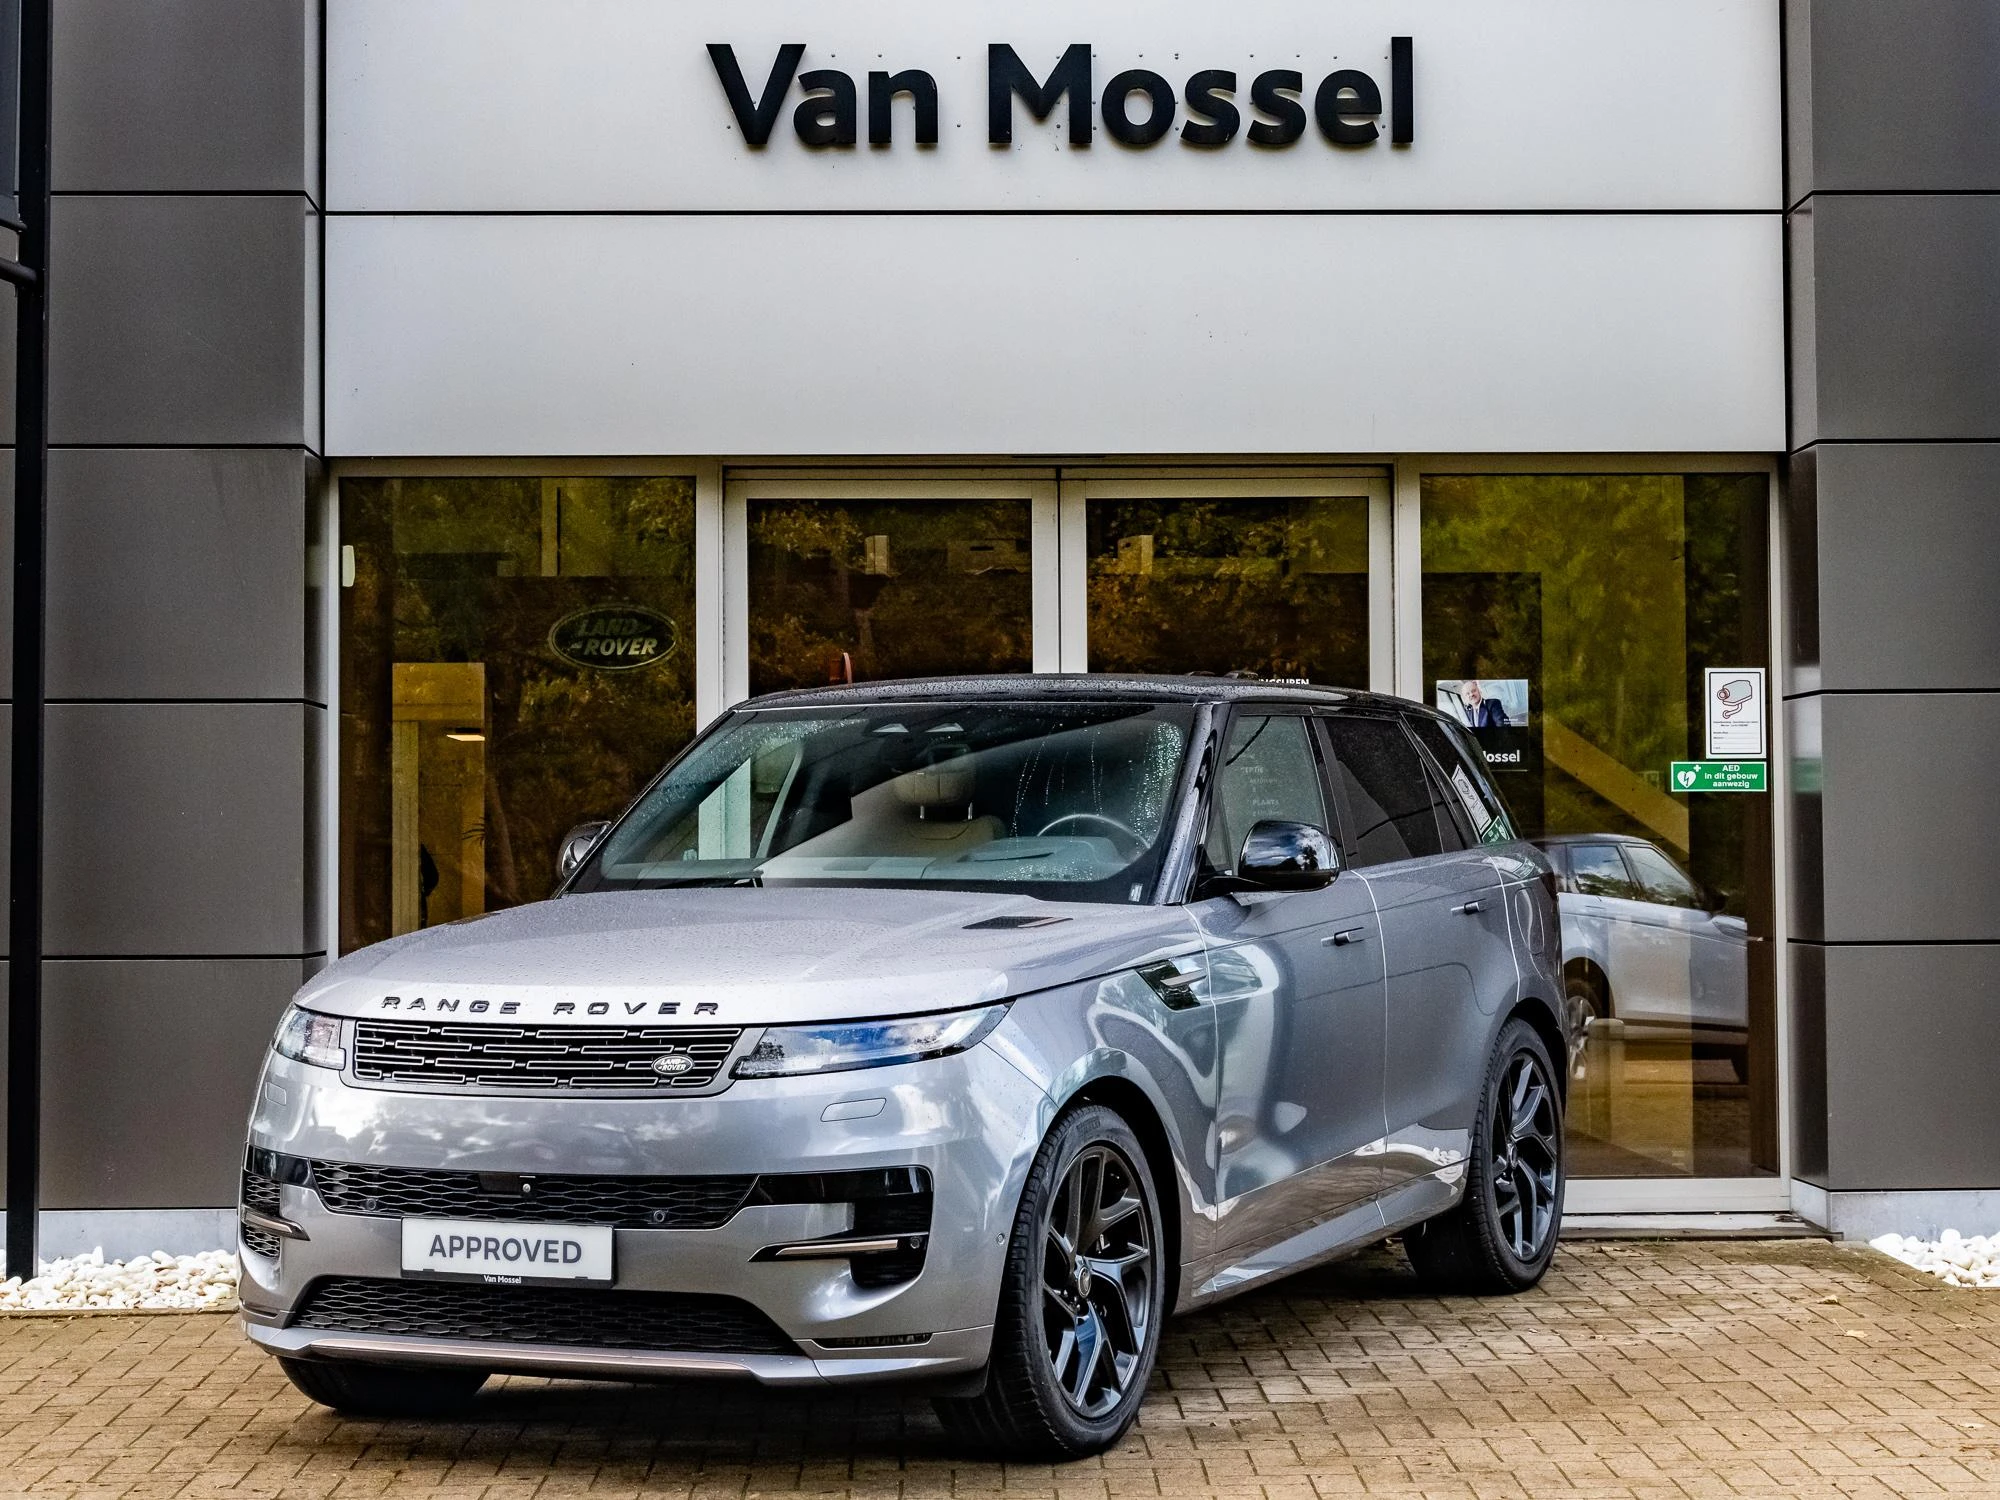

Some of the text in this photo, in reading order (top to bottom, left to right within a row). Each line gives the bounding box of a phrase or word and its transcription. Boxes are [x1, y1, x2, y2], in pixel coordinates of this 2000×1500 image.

[706, 36, 1413, 146] Van Mossel
[577, 618, 639, 637] LAND
[583, 637, 658, 656] ROVER
[1722, 764, 1740, 772] AED
[1726, 772, 1758, 781] gebouw
[1712, 780, 1750, 788] aanwezig
[381, 996, 720, 1015] RANGE ROVER
[428, 1234, 583, 1264] APPROVED
[483, 1274, 522, 1284] Van Mossel
